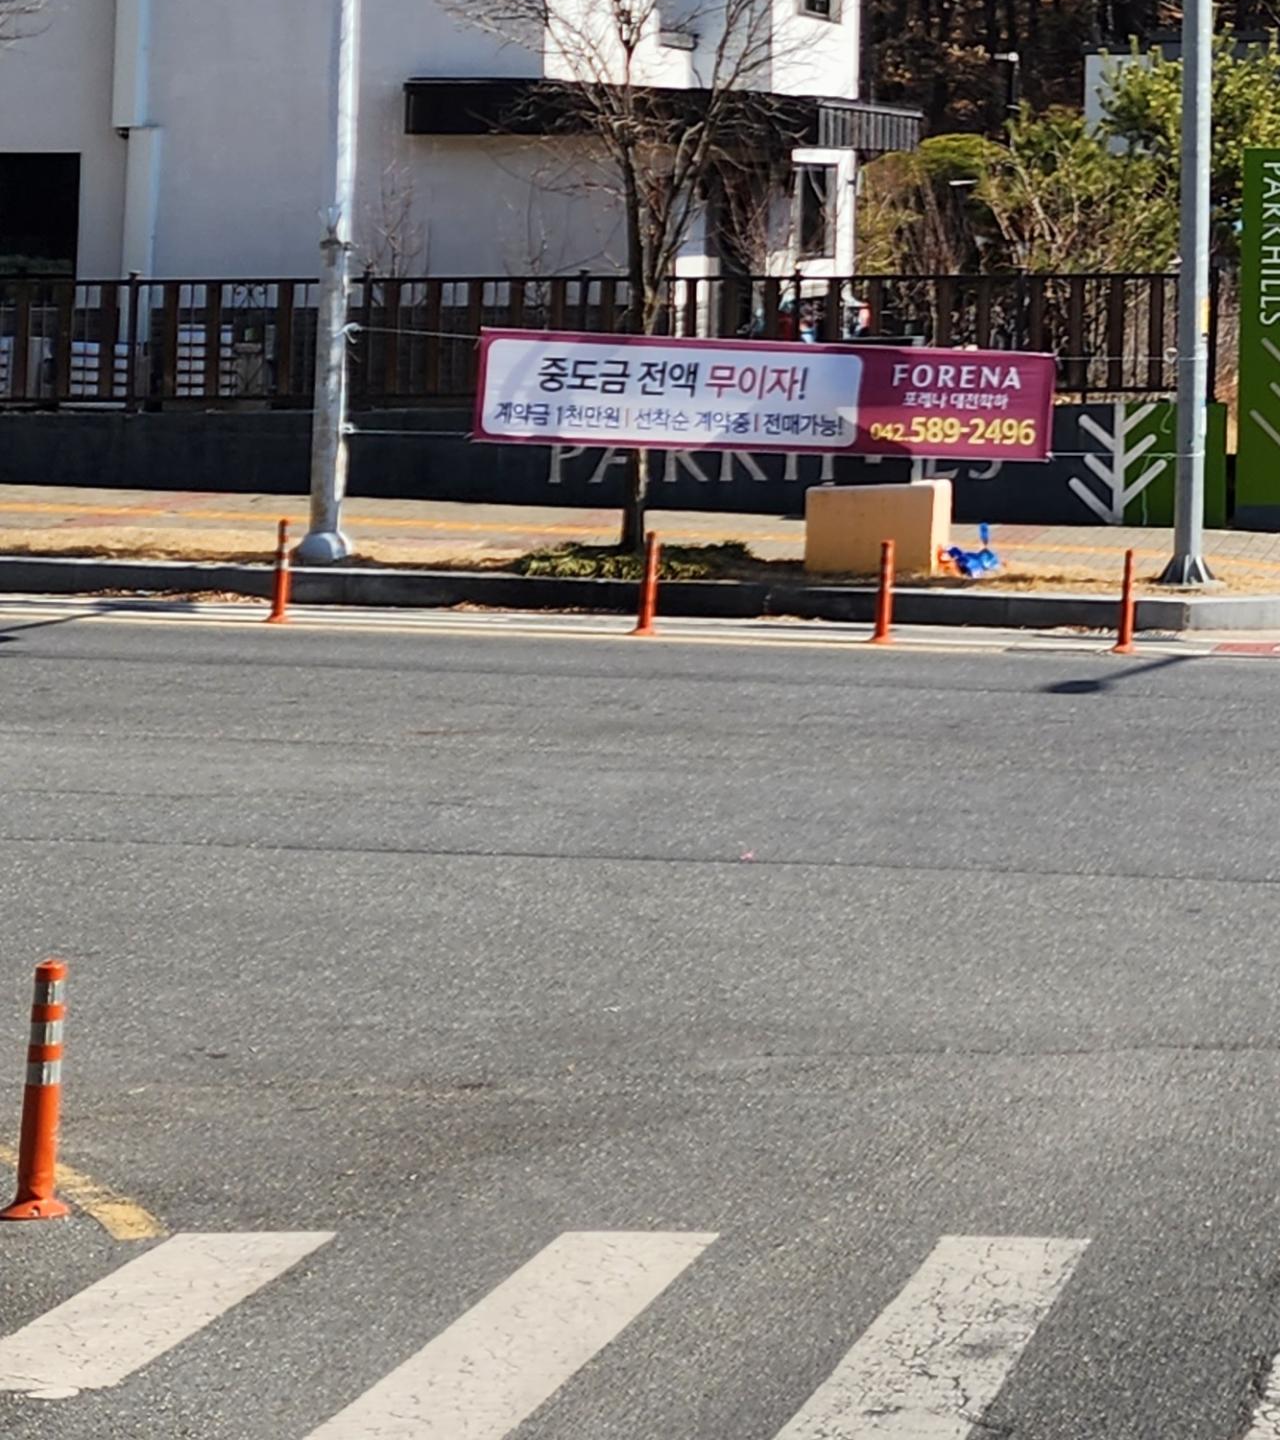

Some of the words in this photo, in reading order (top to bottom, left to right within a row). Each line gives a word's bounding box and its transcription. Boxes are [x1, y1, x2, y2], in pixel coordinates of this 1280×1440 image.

[537, 357, 631, 395] 중도금
[637, 360, 700, 398] 전액
[704, 364, 809, 401] 무이자!
[891, 363, 1022, 390] FORENA
[494, 401, 550, 427] 계약금
[556, 405, 620, 429] 1천만원
[633, 408, 690, 432] 선착순
[694, 410, 750, 435] 계약중
[762, 412, 844, 437] 전매가능!
